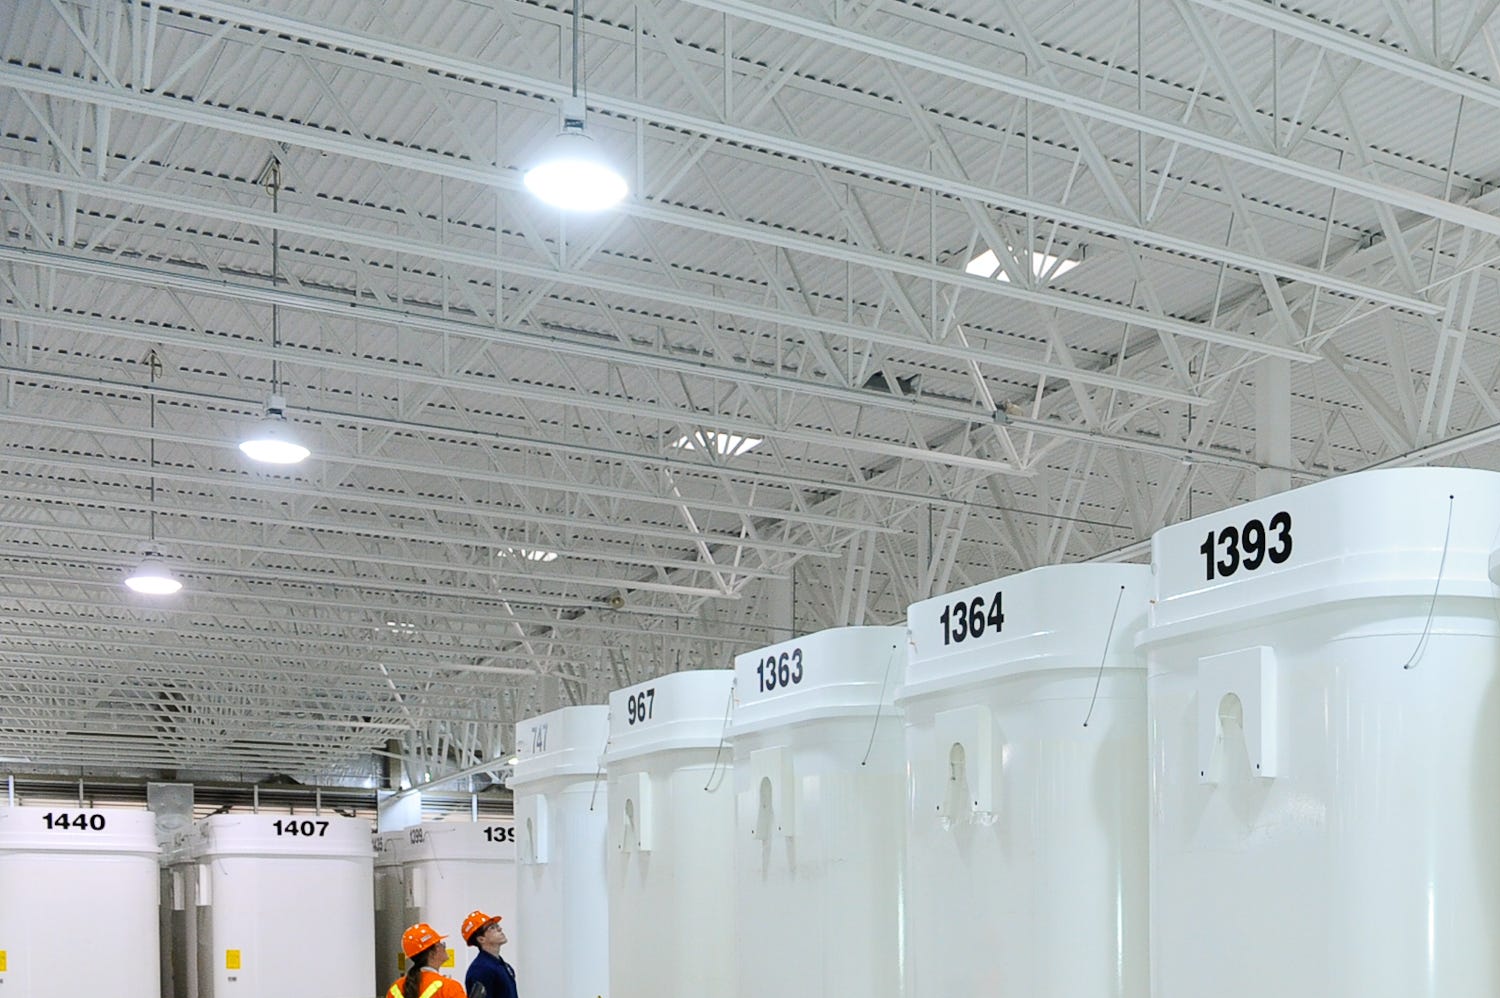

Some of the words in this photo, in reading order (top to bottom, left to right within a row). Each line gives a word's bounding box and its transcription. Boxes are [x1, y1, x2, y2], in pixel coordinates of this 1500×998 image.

[1200, 511, 1293, 582] 1393
[940, 591, 1005, 646] 1364
[756, 647, 804, 693] 1363
[627, 688, 656, 726] 967
[42, 813, 106, 832] 1440
[273, 820, 330, 837] 1407
